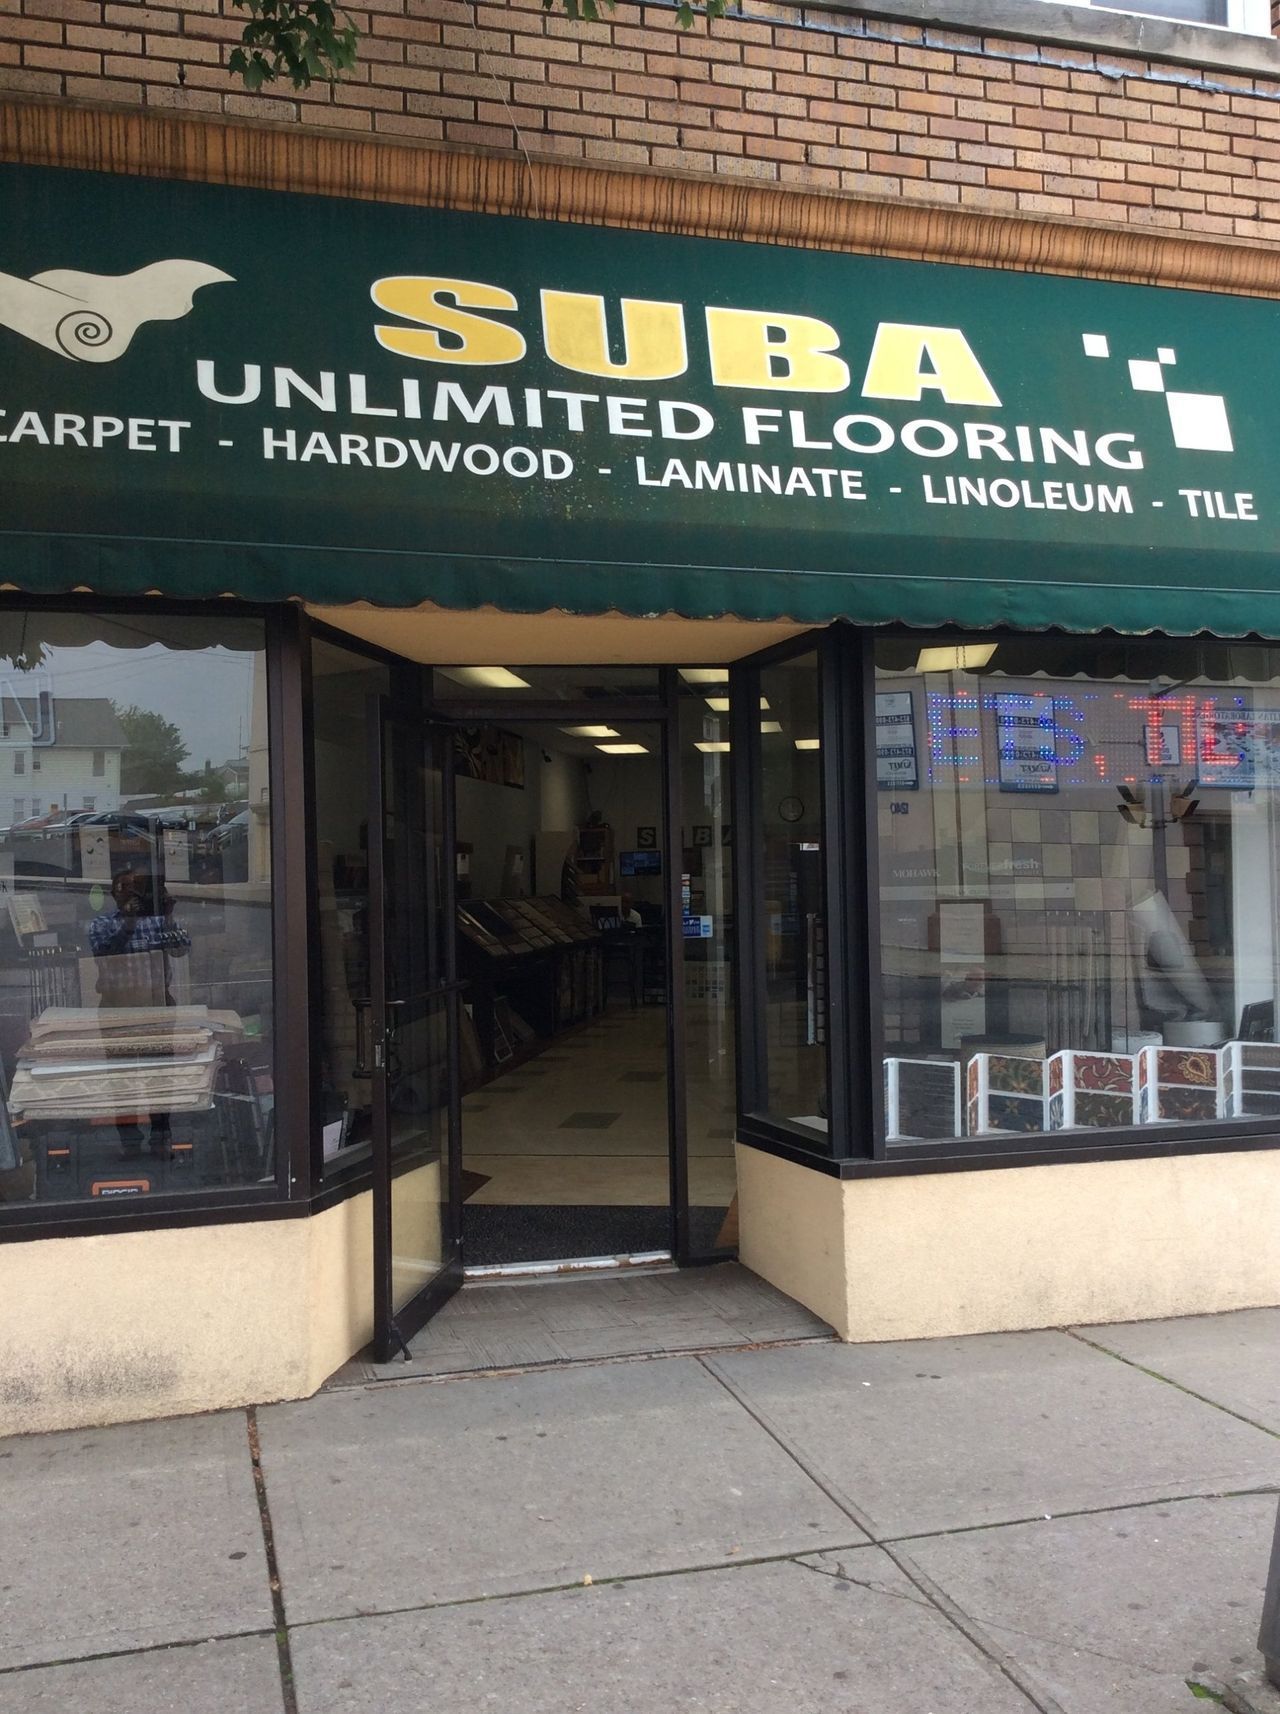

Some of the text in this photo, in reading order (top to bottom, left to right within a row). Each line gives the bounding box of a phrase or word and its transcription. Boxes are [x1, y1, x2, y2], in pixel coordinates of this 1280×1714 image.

[370, 276, 1003, 408] SUBA
[0, 409, 191, 453] ARPET
[263, 428, 574, 480] HARDWOOD
[636, 455, 867, 501] LAMINATE
[922, 474, 1135, 515] LINOLEUM
[1178, 487, 1259, 521] TILE
[196, 360, 1145, 471] UNLIMITED FLOORING
